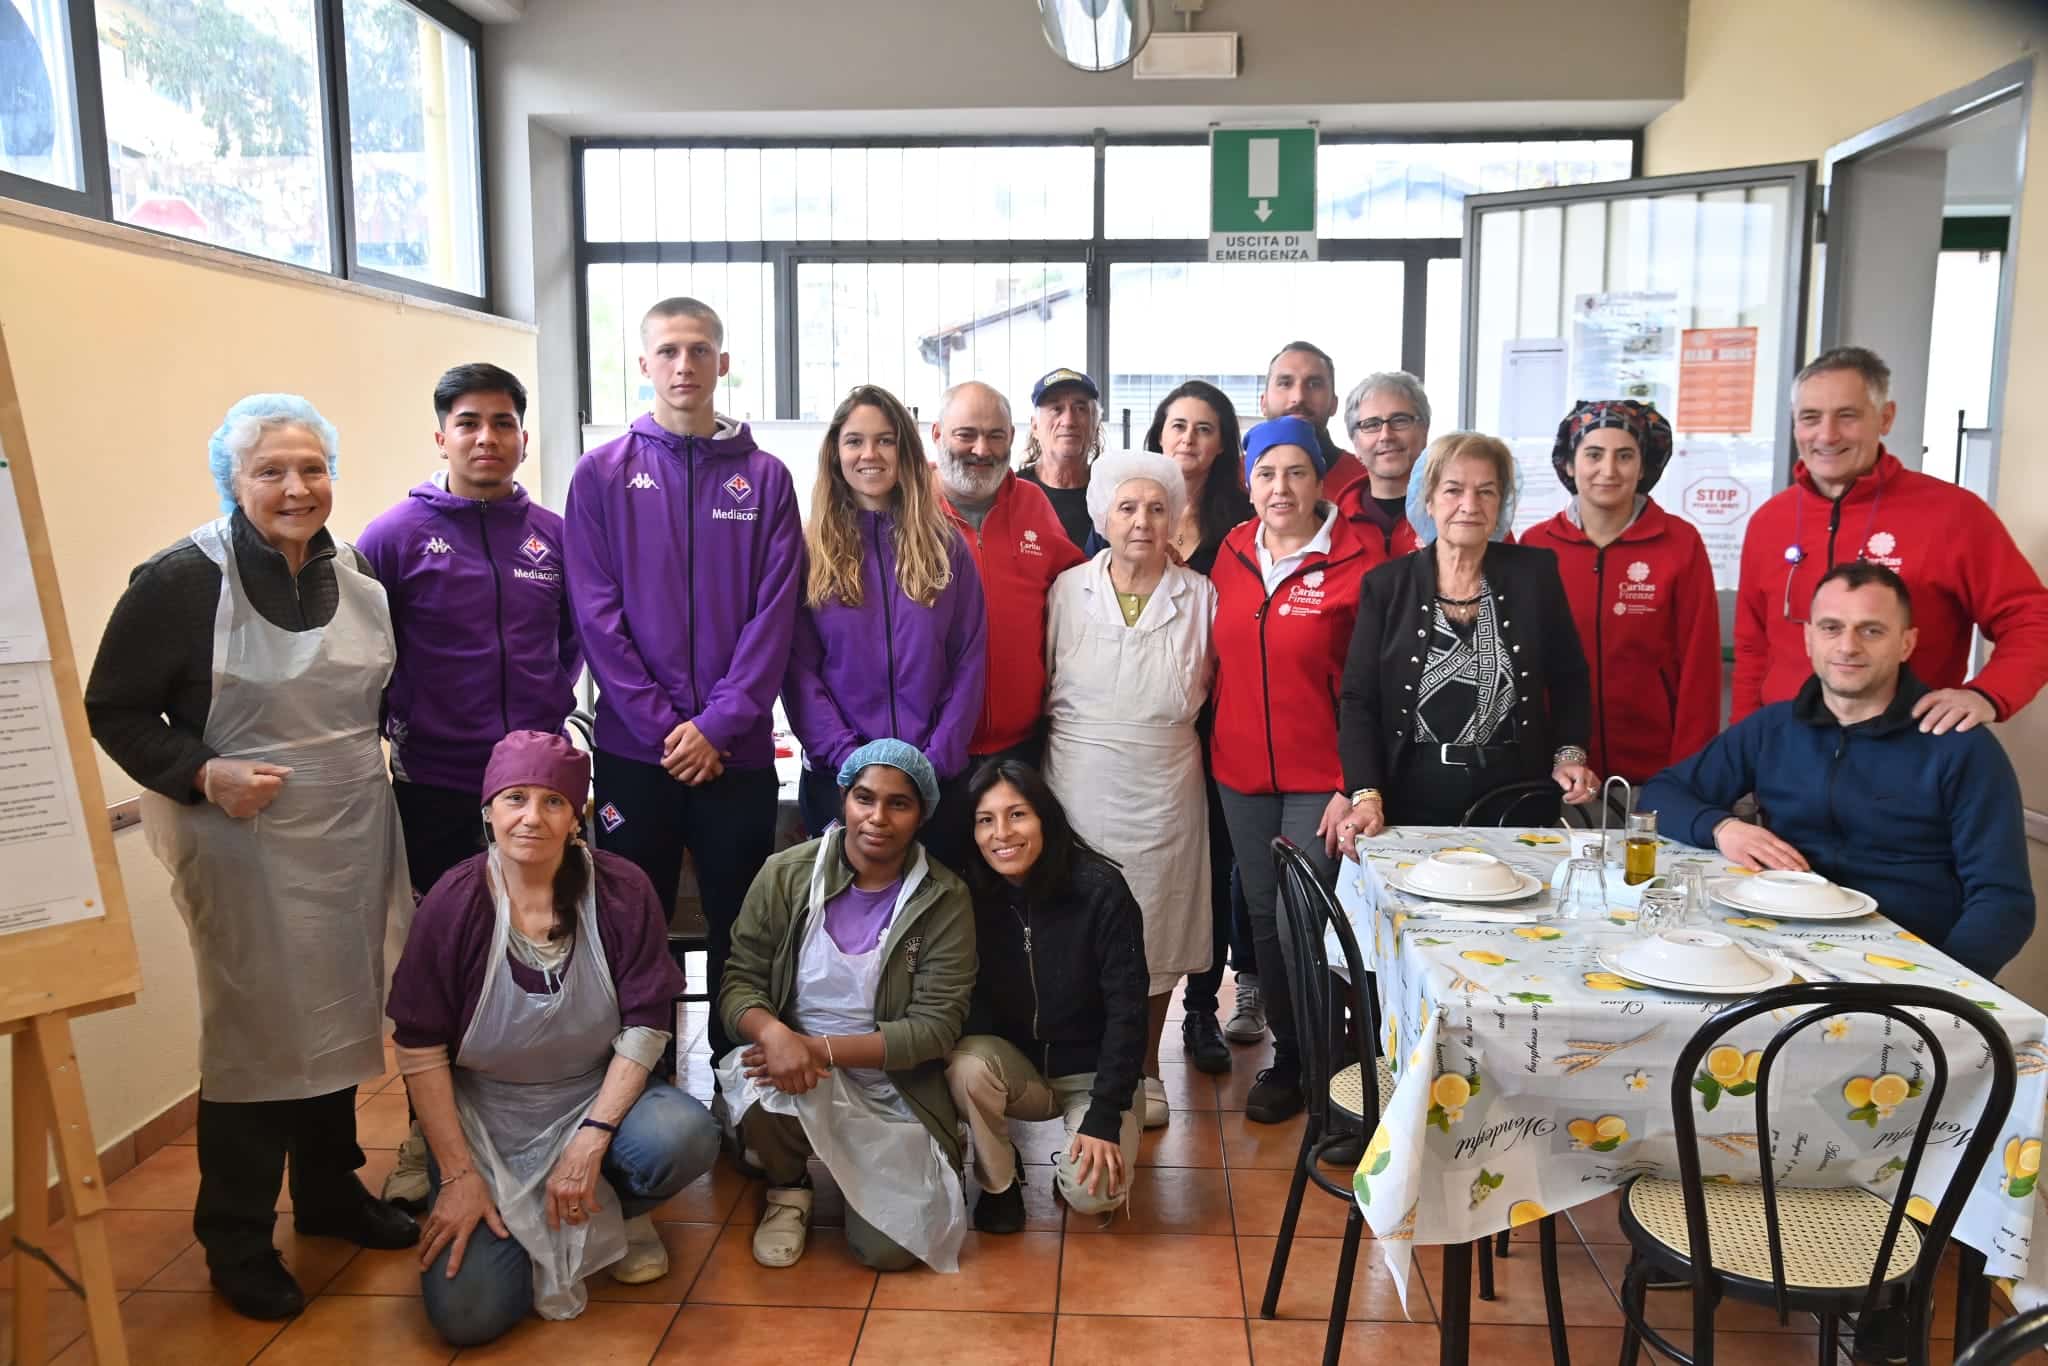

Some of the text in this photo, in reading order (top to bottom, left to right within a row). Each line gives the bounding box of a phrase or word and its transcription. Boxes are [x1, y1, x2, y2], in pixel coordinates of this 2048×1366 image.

[1226, 236, 1300, 247] USCITA DI
[1215, 250, 1309, 261] EMERGENZA
[1696, 489, 1738, 502] STOP
[1290, 585, 1326, 598] Caritas
[1618, 582, 1656, 592] Caritas
[1287, 591, 1323, 605] Firenze
[1619, 591, 1656, 601] Firenze
[1524, 1028, 1541, 1074] everything
[1454, 1116, 1558, 1160] Wonderful
